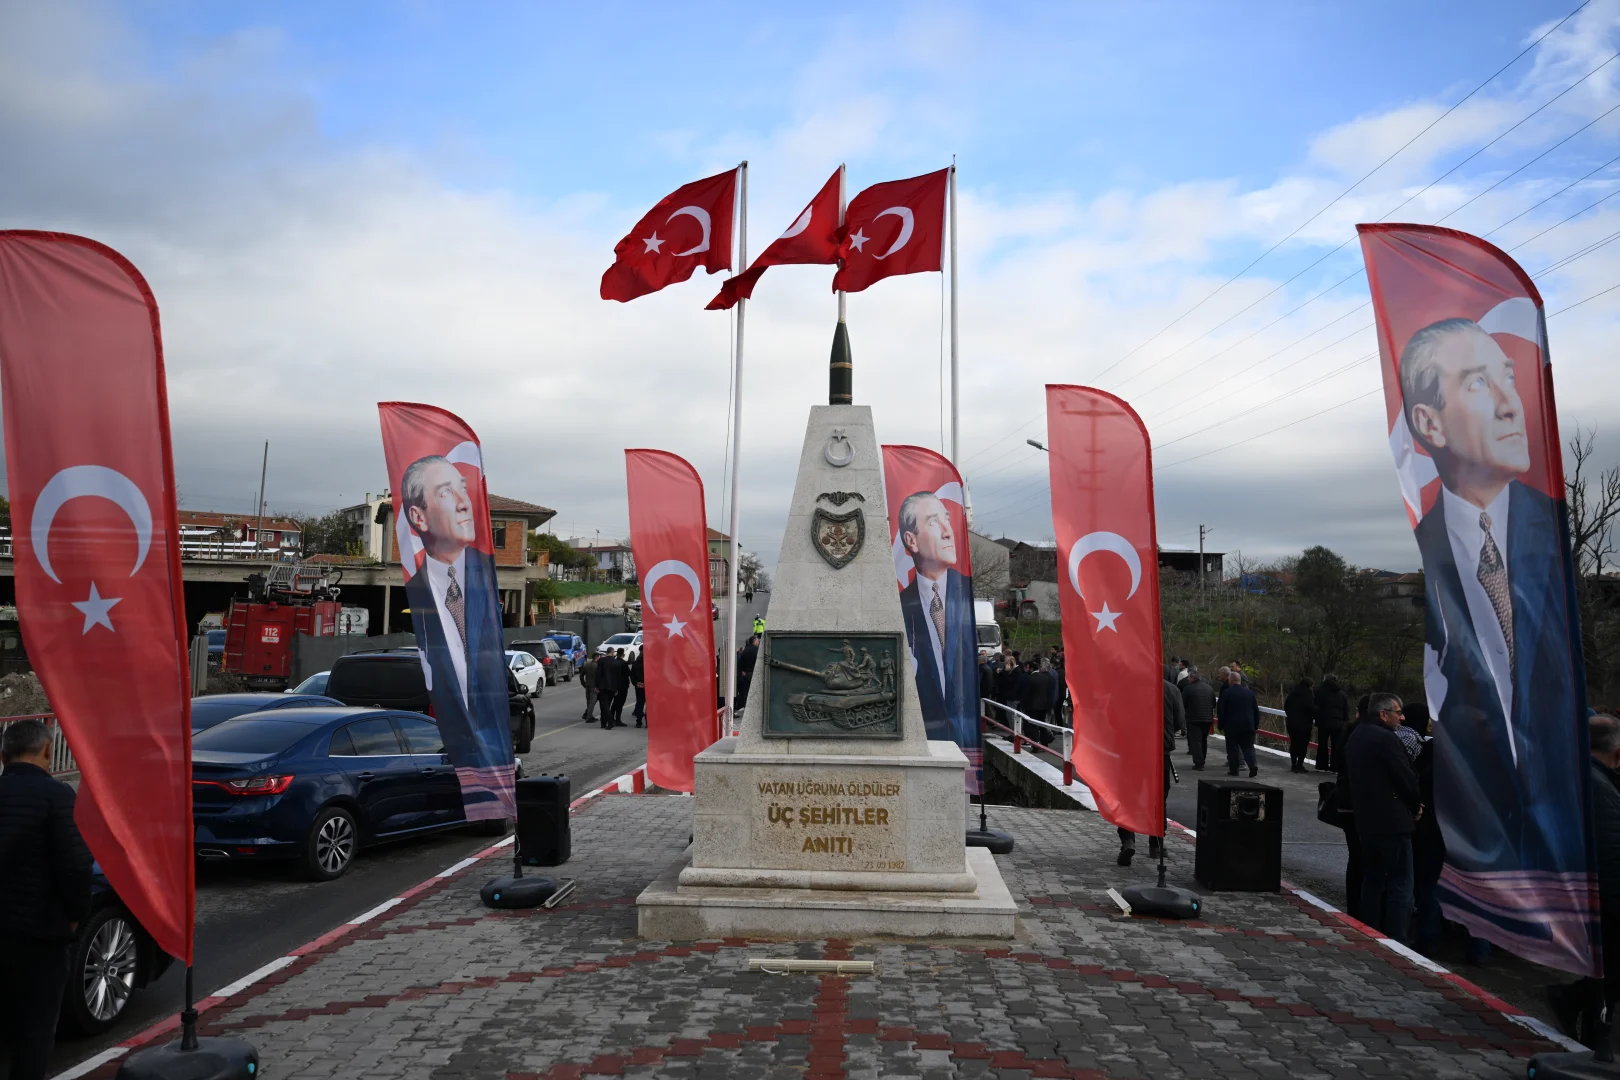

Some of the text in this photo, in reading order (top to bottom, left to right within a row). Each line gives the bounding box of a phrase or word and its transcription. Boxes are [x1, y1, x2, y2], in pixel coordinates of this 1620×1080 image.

[264, 627, 278, 637] 112
[758, 780, 900, 797] VATAN UĞRUNA ÖLDÜLER
[768, 803, 889, 829] ÜÇ ŞEHİTLER
[801, 836, 853, 854] ANITI
